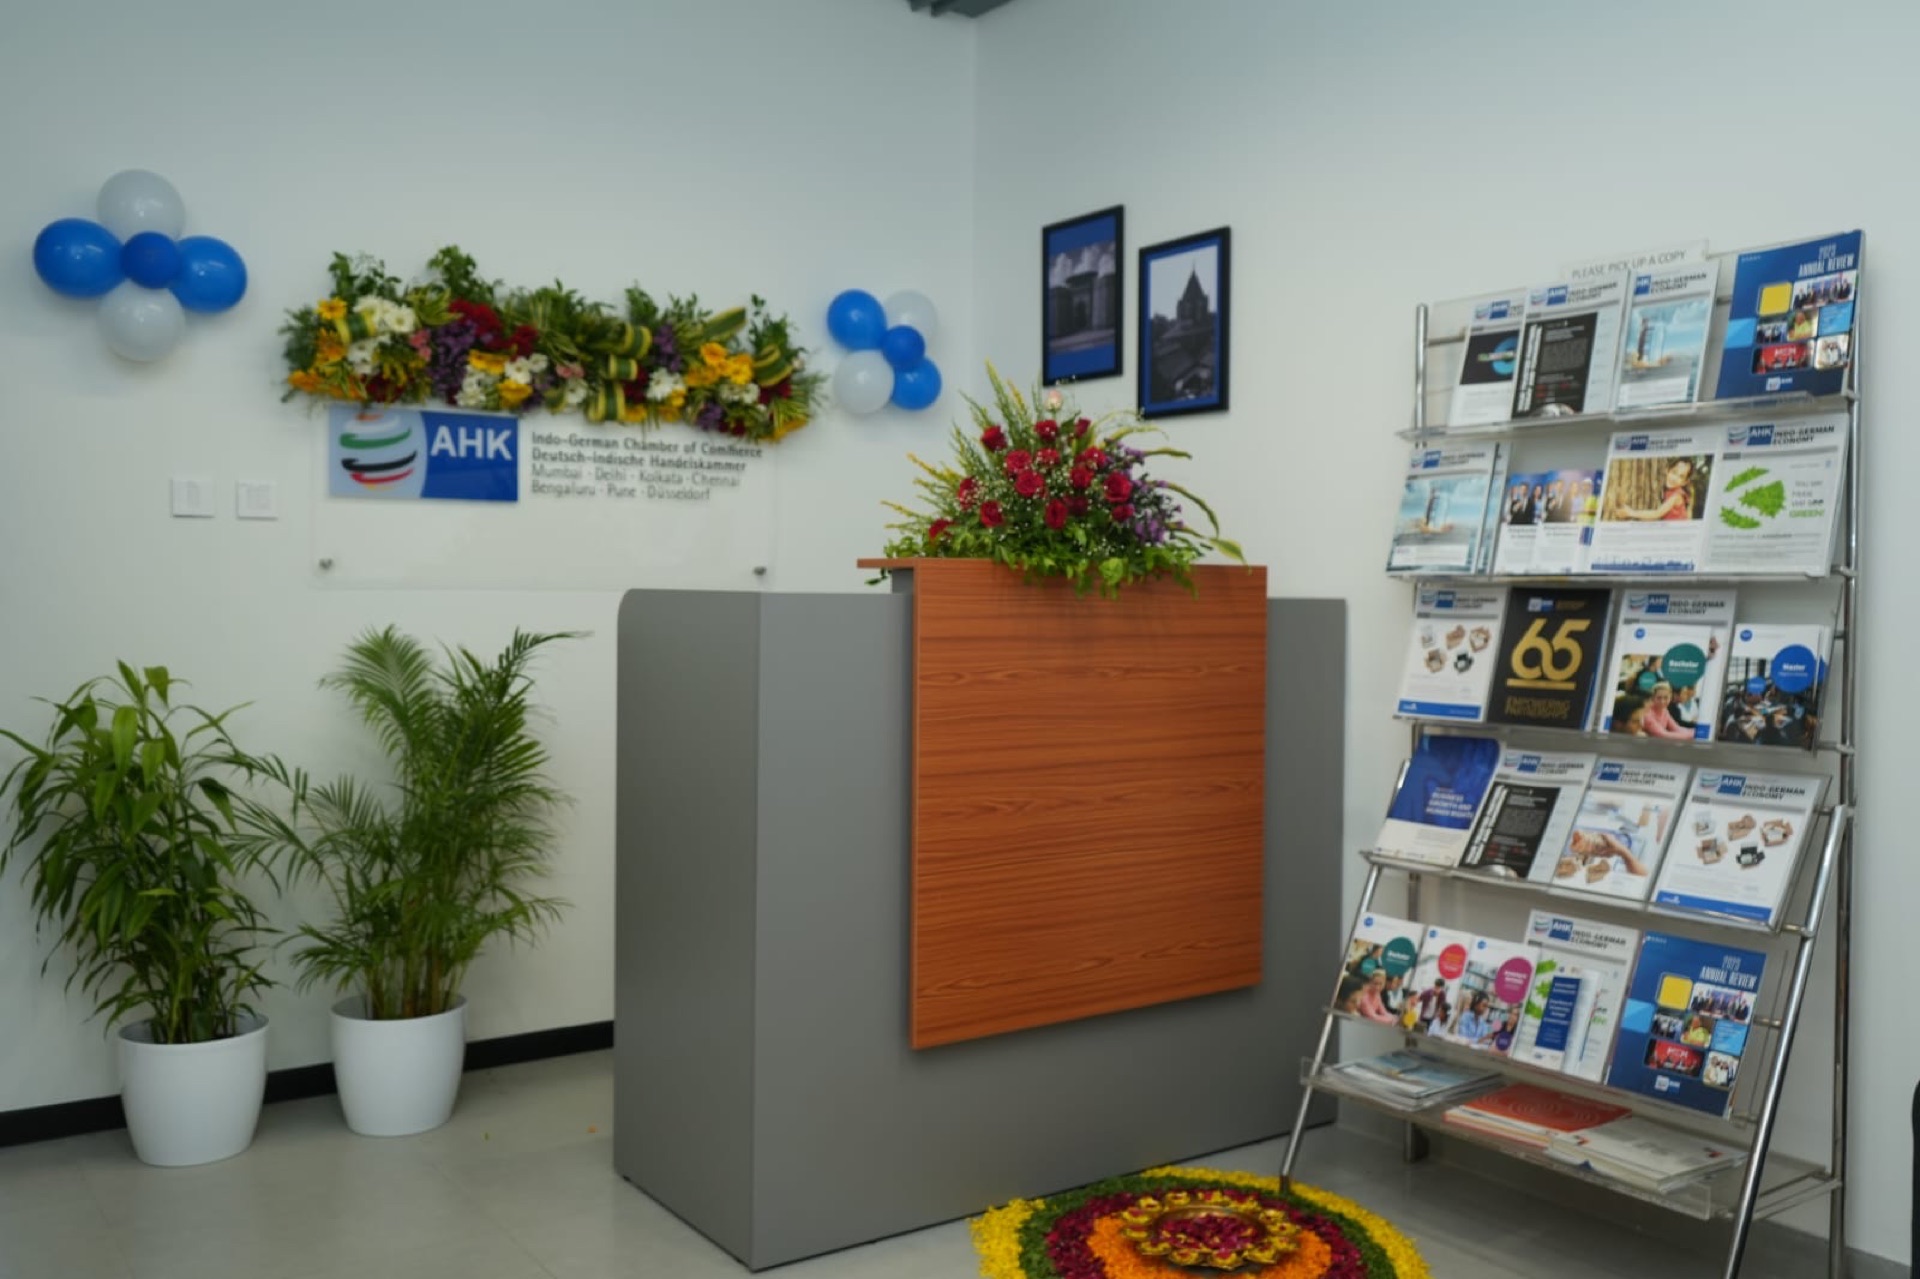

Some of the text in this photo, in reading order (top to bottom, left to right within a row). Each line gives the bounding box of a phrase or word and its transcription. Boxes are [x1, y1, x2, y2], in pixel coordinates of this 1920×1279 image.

[1572, 264, 1604, 279] PLEASE
[1608, 261, 1629, 273] PICK
[1632, 256, 1646, 269] UP
[1660, 250, 1686, 265] COPY
[1798, 253, 1854, 278] ANNUAL REVIEW
[532, 432, 619, 449] Indo-German
[624, 437, 679, 452] Chamber
[684, 441, 696, 453] of
[1750, 426, 1774, 438] AHK
[1772, 435, 1814, 446] ECONOMY
[430, 425, 512, 461] AHK
[651, 456, 746, 472] Handelskammer
[532, 464, 739, 487] Mumbai Delhi Kolkata Chennai
[532, 480, 710, 500] Bengaluru Pune Düsseldorf
[1511, 617, 1591, 681] 65
[1721, 776, 1745, 788] AHK
[1551, 921, 1572, 933] AHK
[1700, 966, 1758, 988] ANNUAL REVIEW
